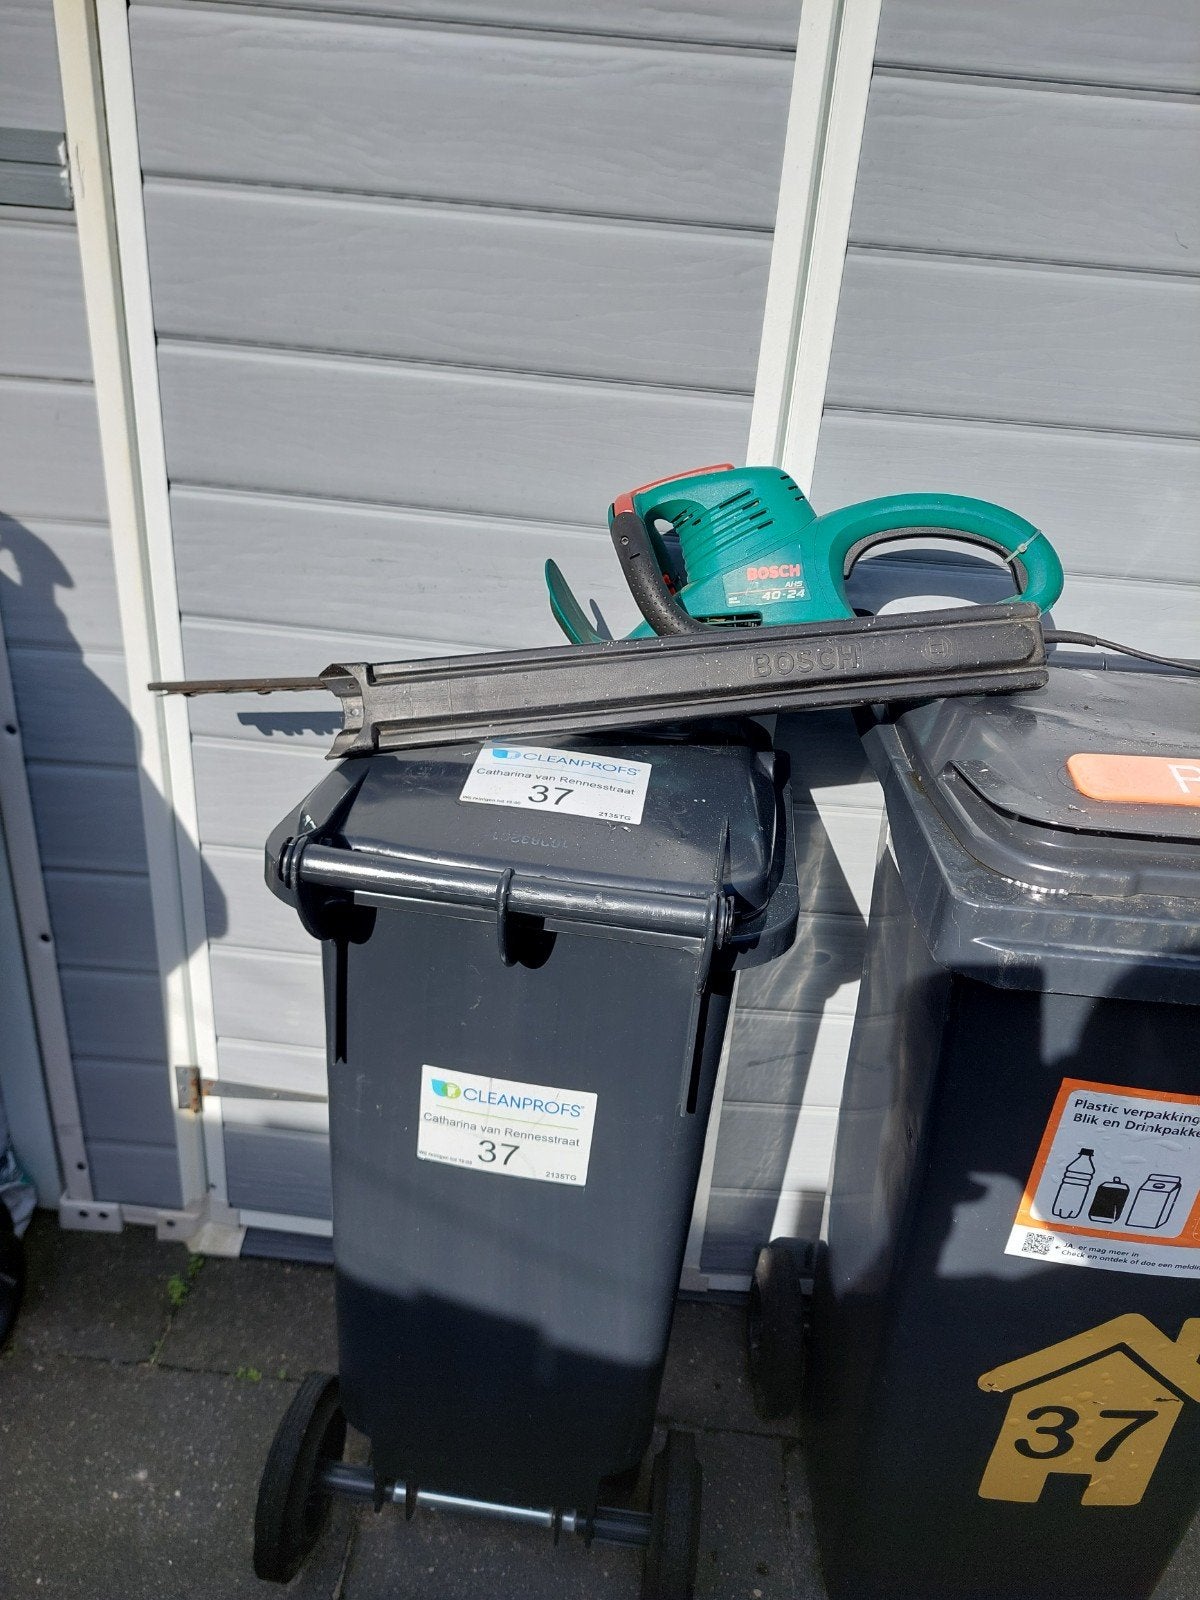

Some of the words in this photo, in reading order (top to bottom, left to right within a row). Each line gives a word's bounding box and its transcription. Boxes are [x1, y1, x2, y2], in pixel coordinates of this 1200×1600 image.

[746, 564, 800, 580] BOSCH
[753, 644, 860, 678] BOSCH
[524, 753, 638, 776] CLEANPROFS
[476, 768, 532, 779] Catharina
[559, 777, 635, 795] Rennesstraat
[528, 785, 574, 805] 37
[464, 1088, 581, 1118] CLEANPROFS
[1074, 1099, 1118, 1114] Plastic
[424, 1112, 477, 1131] Catharina
[481, 1126, 501, 1136] van
[505, 1127, 580, 1147] Rennesstraat
[1073, 1113, 1098, 1126] Blik
[1103, 1119, 1120, 1128] en
[478, 1140, 520, 1166] 37
[546, 1171, 577, 1181] 2135TG
[1062, 1250, 1085, 1258] Check
[1100, 1255, 1128, 1264] ontdek
[1014, 1405, 1158, 1462] 37
